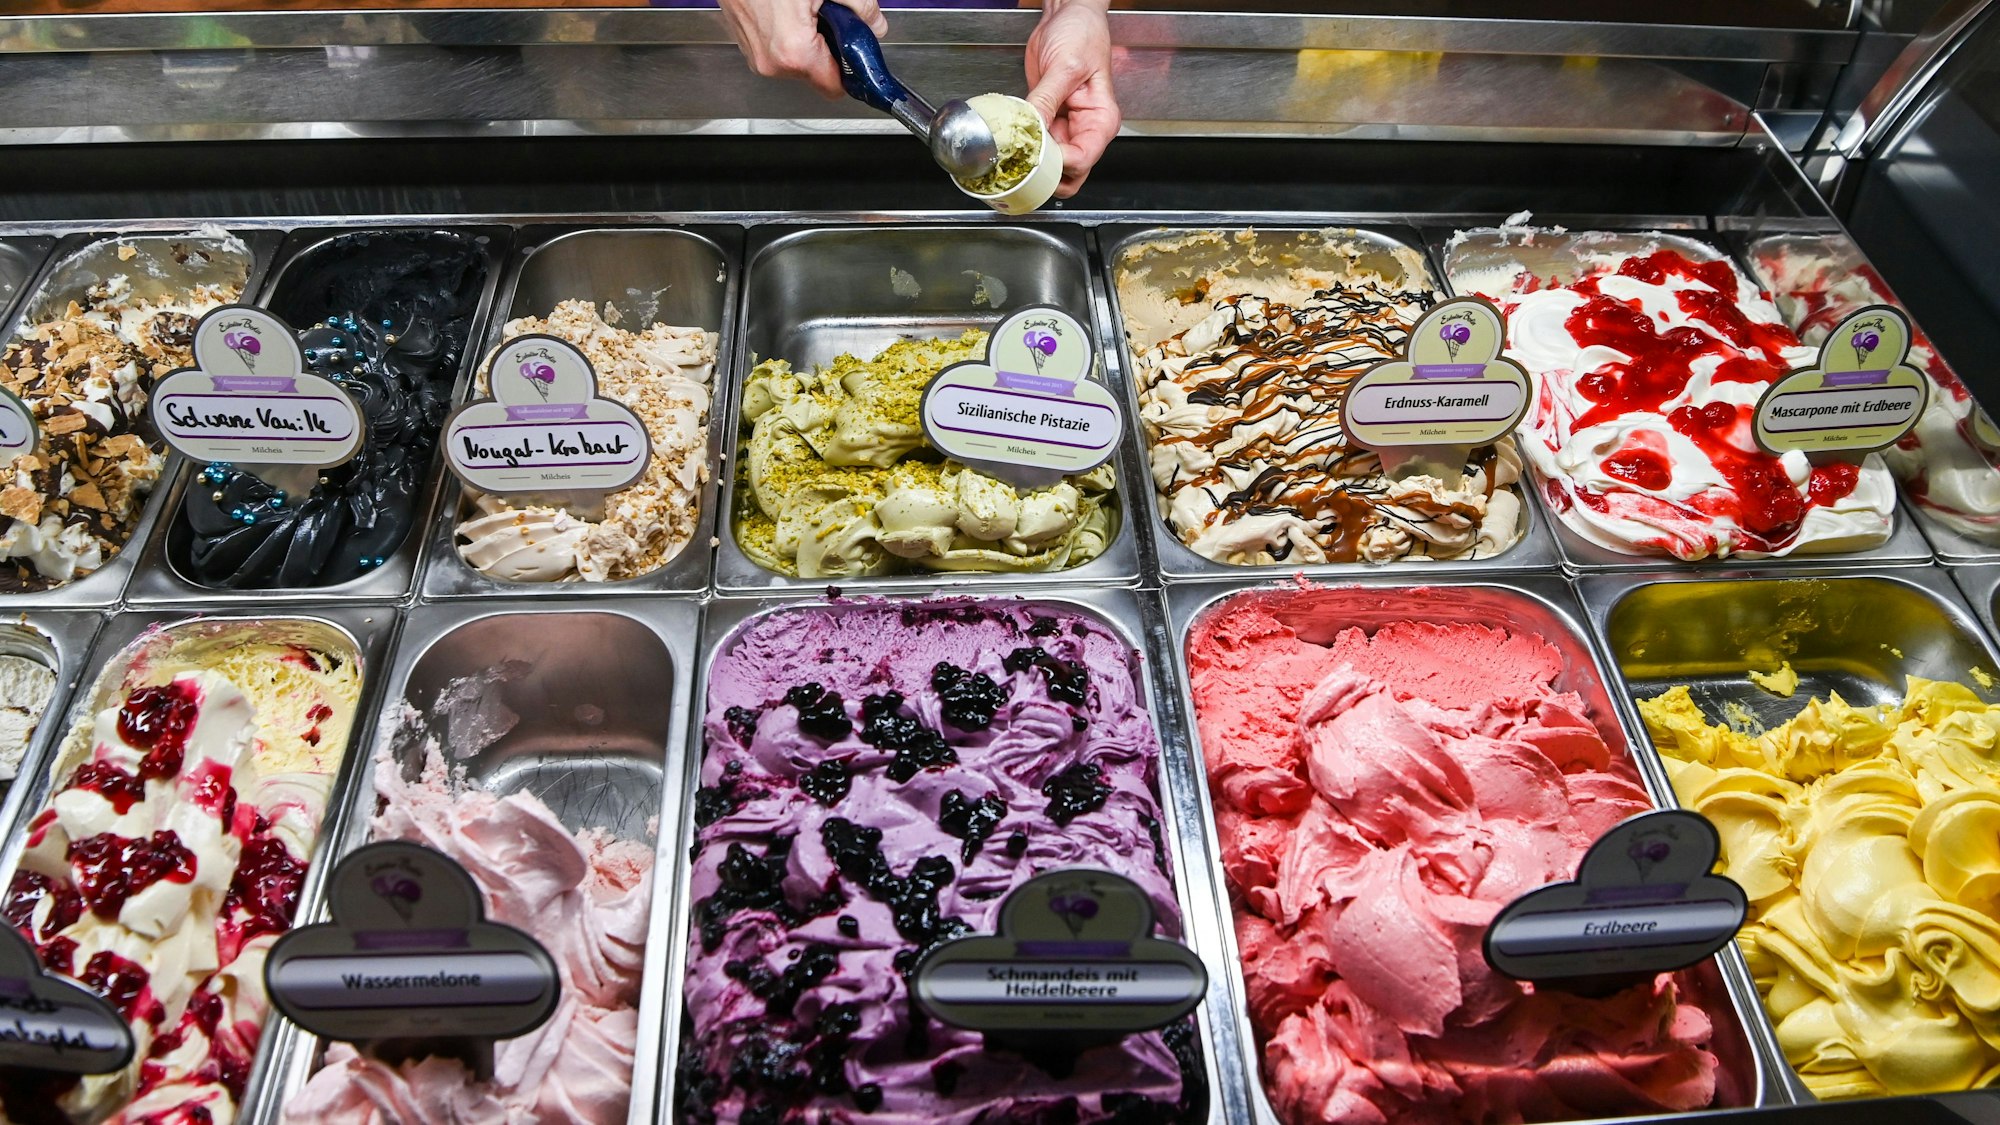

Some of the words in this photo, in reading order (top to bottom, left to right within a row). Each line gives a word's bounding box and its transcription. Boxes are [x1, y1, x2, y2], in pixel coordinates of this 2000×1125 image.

[1384, 394, 1490, 410] Erdnuss-Karamell
[1771, 404, 1839, 420] Mascarpone
[1840, 401, 1861, 414] mit
[1863, 399, 1912, 413] Erdbeere
[957, 401, 1037, 426] Sizilianische
[1040, 413, 1091, 433] Pistazie
[1419, 428, 1446, 436] Milcheis
[1823, 434, 1849, 442] Milcheis
[251, 445, 284, 454] Milcheis
[1006, 444, 1037, 456] Milcheis
[540, 472, 571, 481] Milcheis
[1583, 920, 1658, 936] Erdbeere
[341, 970, 482, 990] Wassermelone
[987, 966, 1100, 982] Schmandeis
[1105, 966, 1139, 982] mit
[1005, 982, 1118, 997] Heidelbeere
